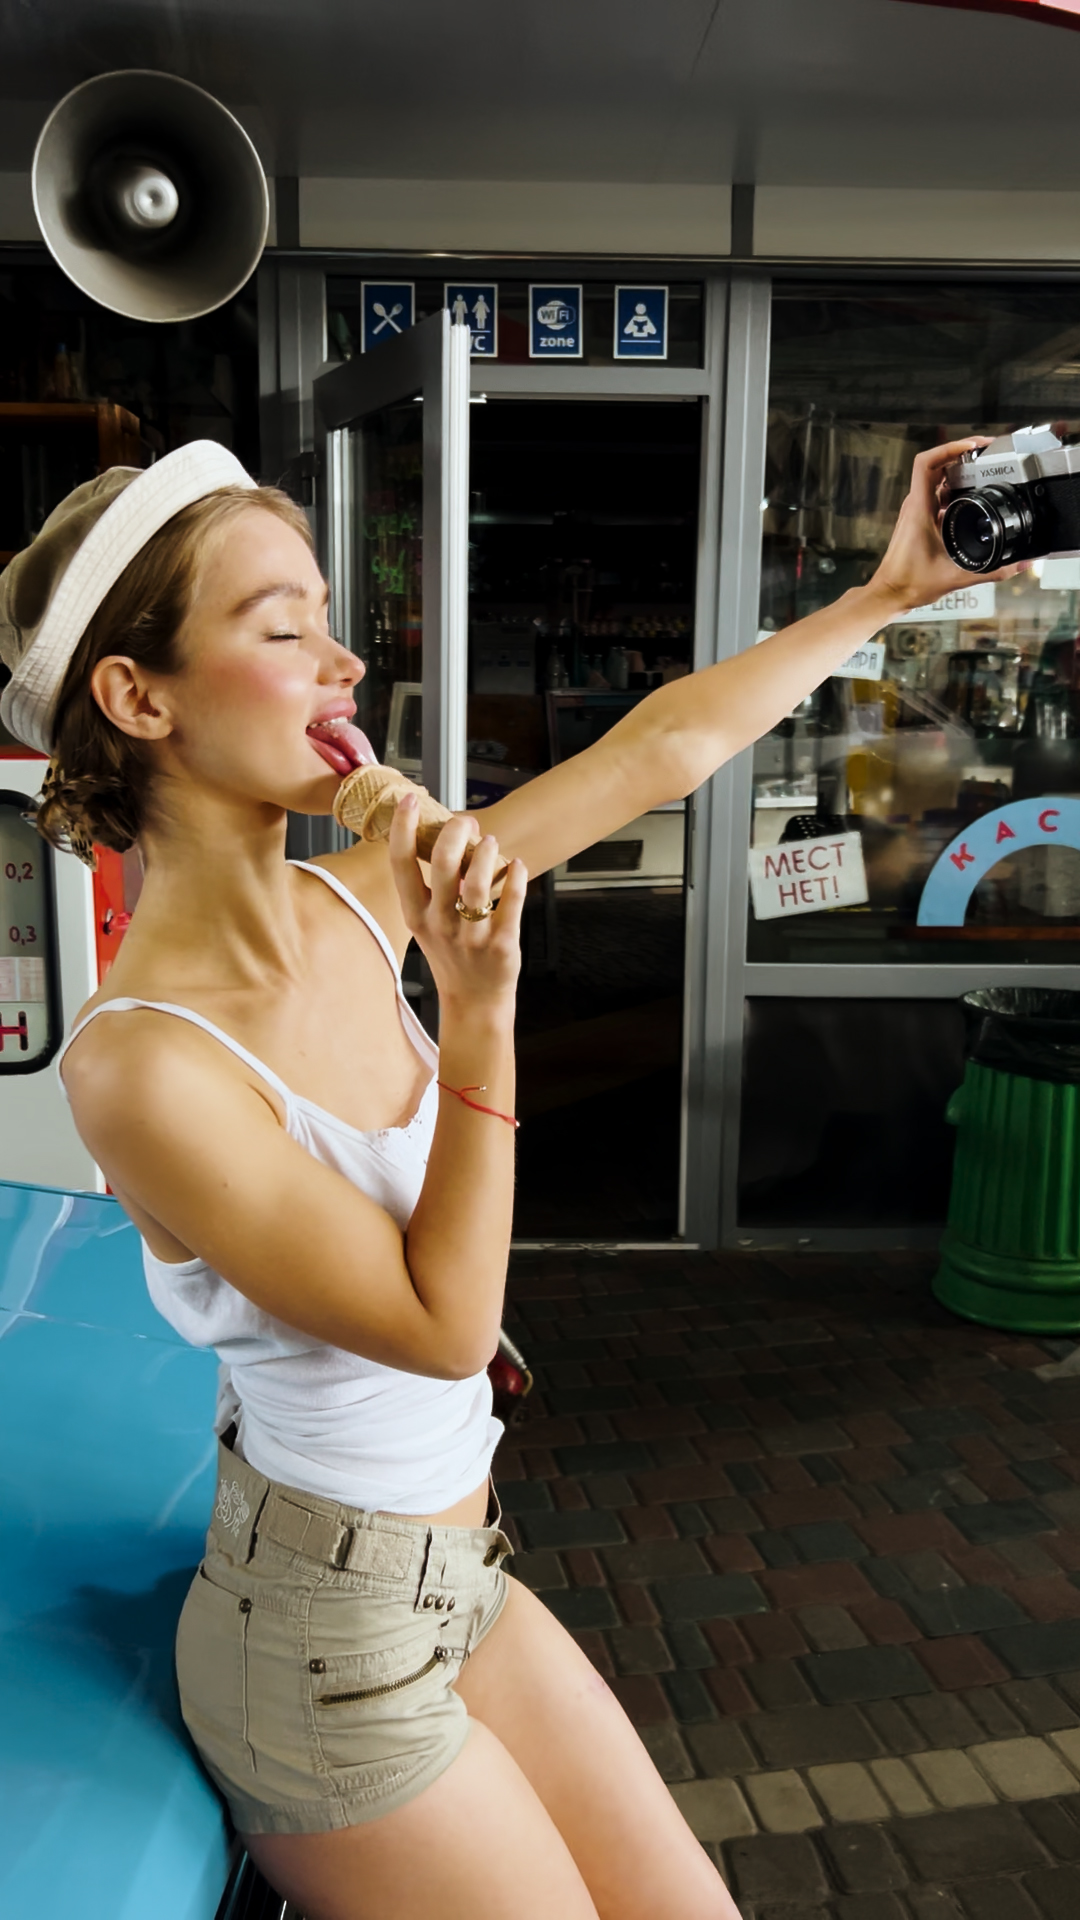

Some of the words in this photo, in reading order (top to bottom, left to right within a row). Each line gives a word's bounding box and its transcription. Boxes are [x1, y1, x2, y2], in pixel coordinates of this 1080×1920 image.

[470, 336, 486, 351] C
[539, 337, 576, 348] zone
[980, 465, 1015, 478] YASHICA
[765, 842, 845, 879] МЕСТ
[5, 862, 34, 883] 0,2
[778, 875, 840, 908] НЕТ!
[9, 925, 37, 946] 0,3
